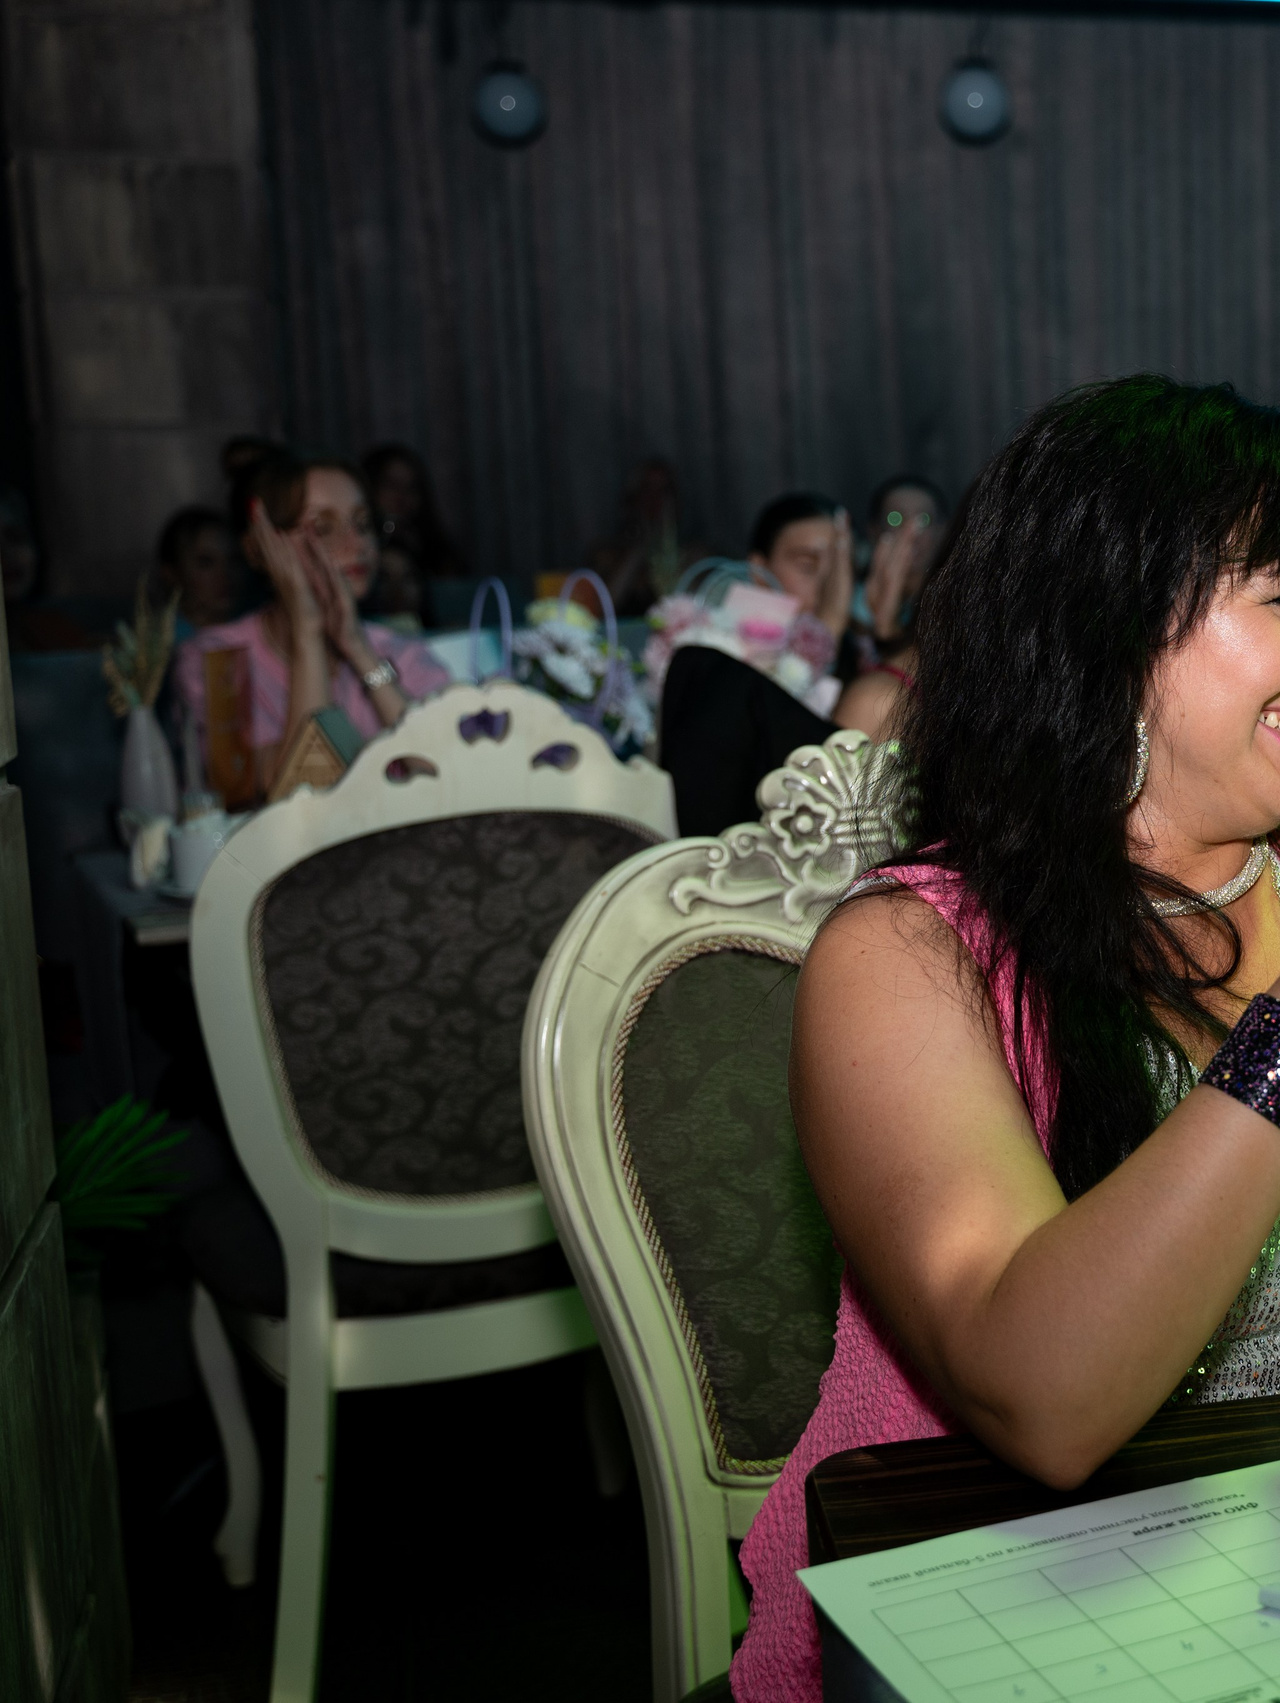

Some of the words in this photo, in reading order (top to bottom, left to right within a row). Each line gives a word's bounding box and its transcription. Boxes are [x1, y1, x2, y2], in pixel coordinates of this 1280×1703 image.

[1148, 1503, 1189, 1520] выход
[1177, 1509, 1222, 1526] члена
[1222, 1500, 1259, 1515] ФИО
[1088, 1511, 1148, 1534] участниц
[1130, 1517, 1176, 1538] жюри
[1005, 1527, 1089, 1554] оценивается
[912, 1552, 985, 1578] 5-бальной
[866, 1571, 912, 1590] шкале
